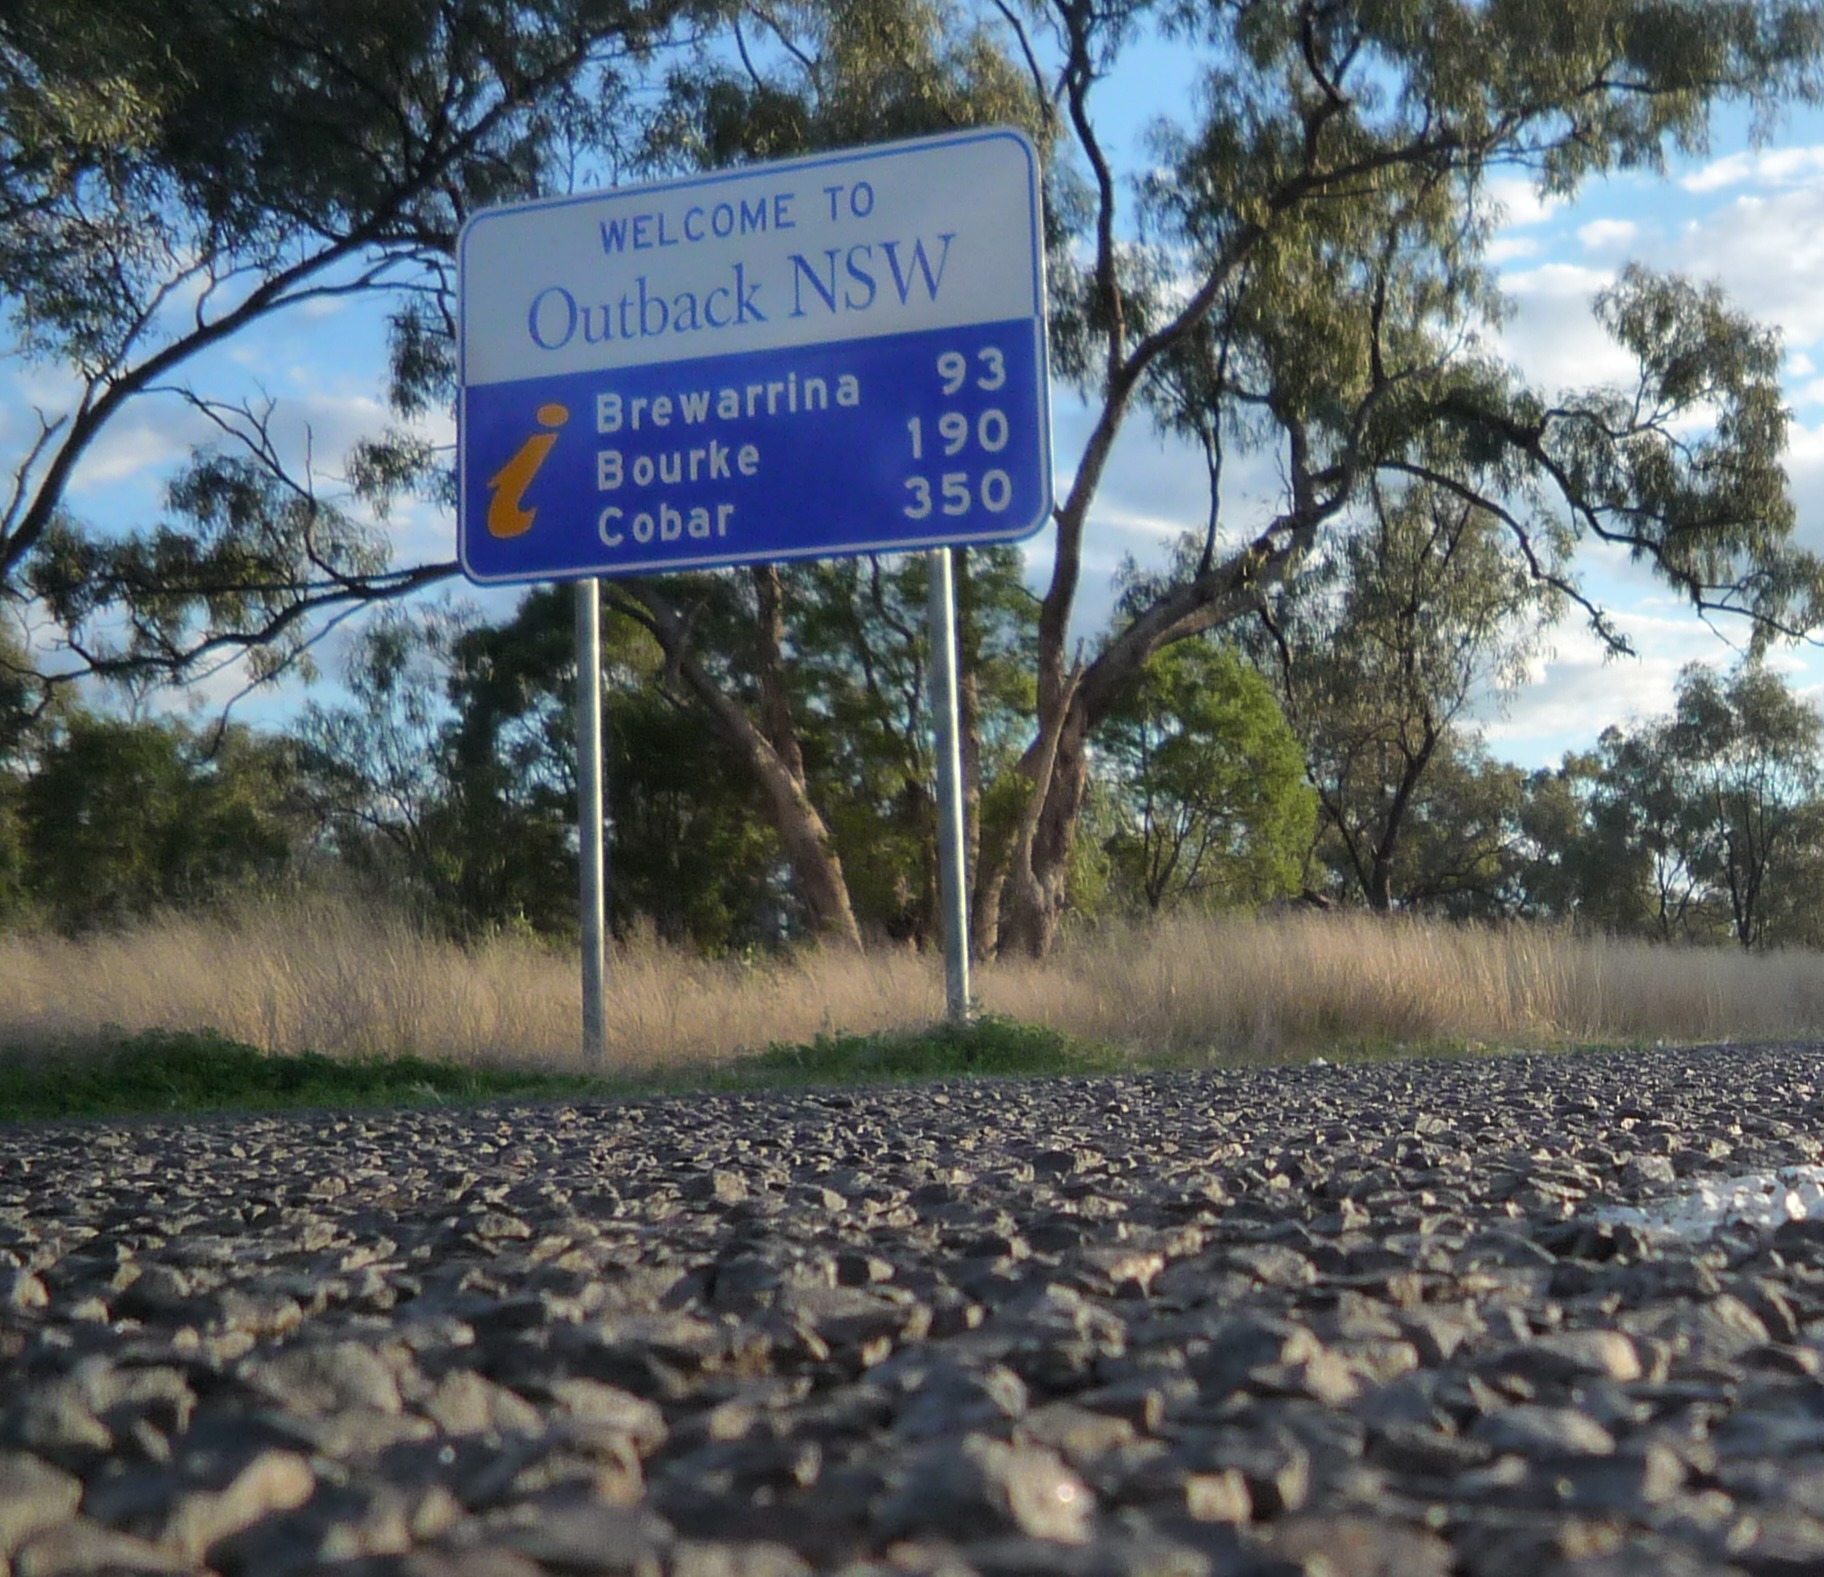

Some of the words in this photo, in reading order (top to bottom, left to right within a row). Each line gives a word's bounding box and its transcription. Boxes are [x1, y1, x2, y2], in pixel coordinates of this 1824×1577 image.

[600, 193, 796, 255] WELCOME
[824, 181, 875, 221] TO
[528, 263, 768, 351] Outback
[788, 233, 957, 318] NSW
[597, 374, 860, 434] Brewarrina
[937, 348, 1006, 395] 93
[597, 440, 760, 491] Bourke
[906, 410, 1010, 460] 190
[599, 503, 734, 547] Cobar
[903, 470, 1012, 520] 350
